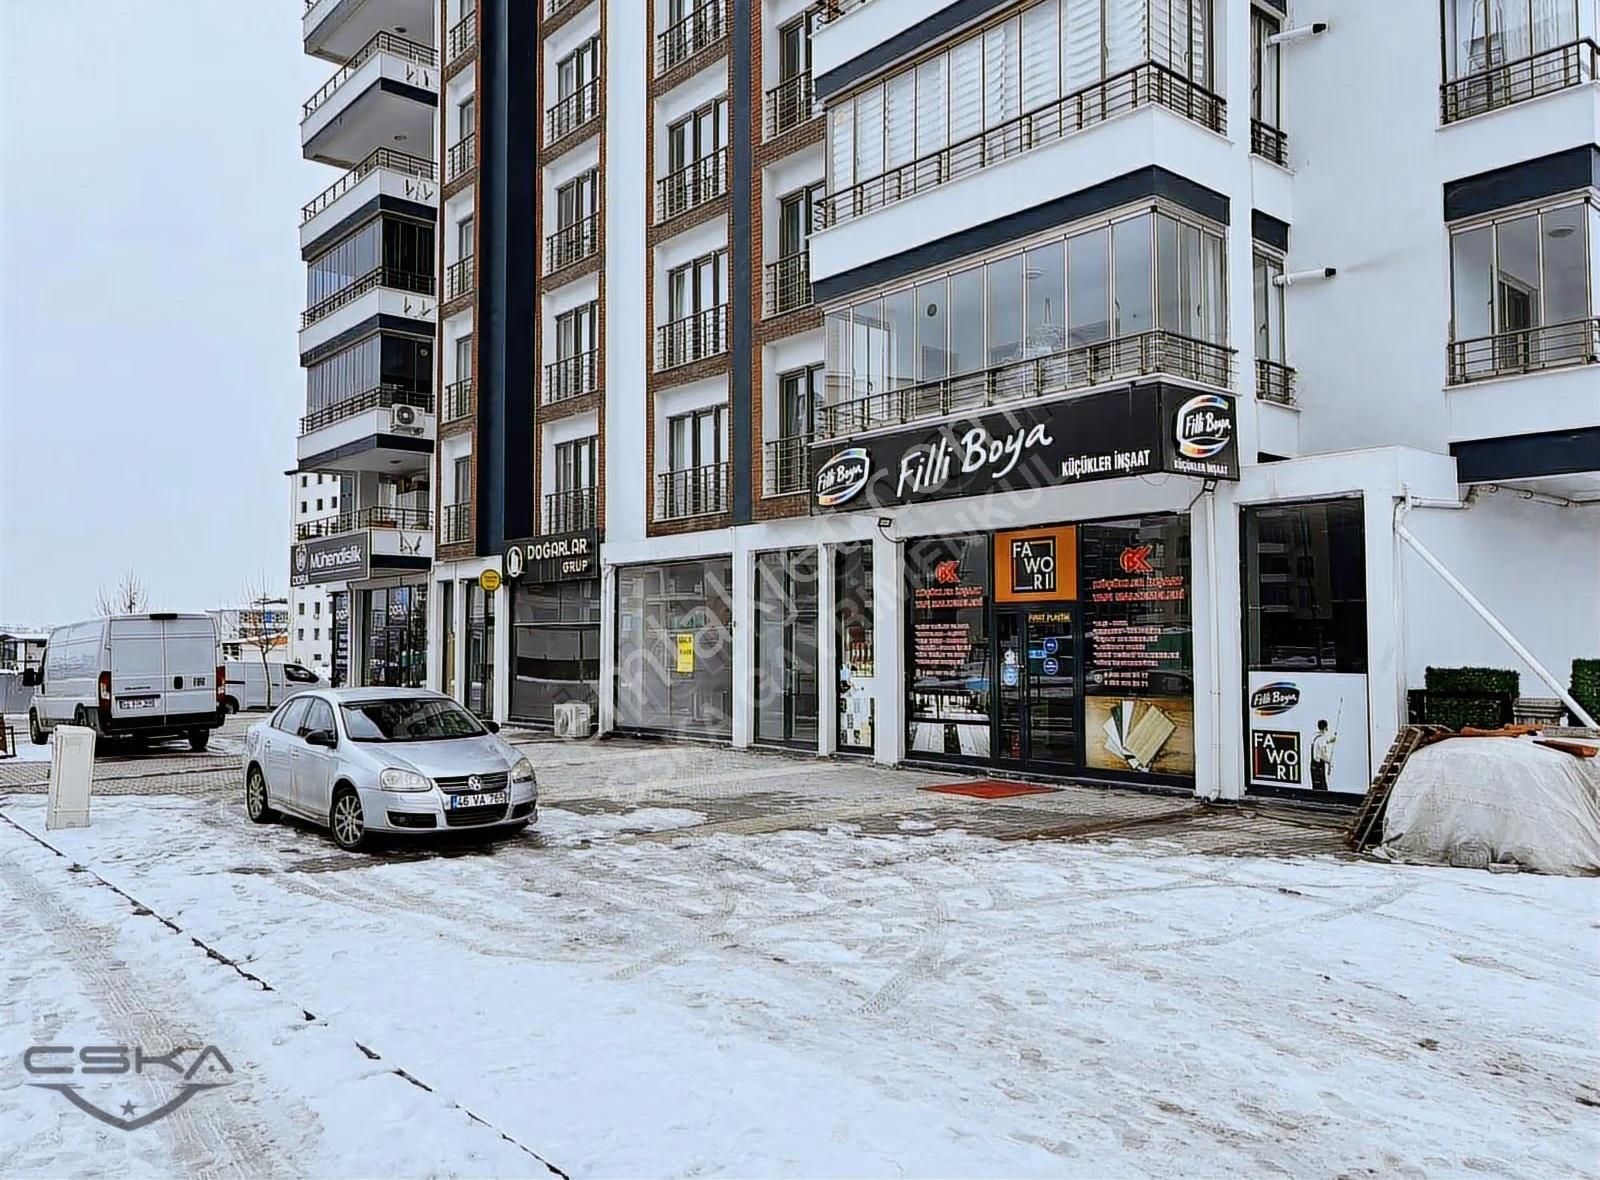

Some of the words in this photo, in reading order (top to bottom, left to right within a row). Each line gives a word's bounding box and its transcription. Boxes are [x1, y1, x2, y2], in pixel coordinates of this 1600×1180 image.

[1185, 412, 1204, 437] Filli
[1205, 412, 1231, 437] Boya
[896, 436, 953, 497] Filli
[961, 423, 1053, 478] Boya
[1061, 458, 1111, 480] KÜÇÜKLER
[1114, 449, 1150, 472] İNŞAAT
[817, 468, 835, 493] Filli
[837, 465, 863, 484] Boya
[527, 538, 587, 560] DOĞARLAR
[562, 559, 588, 573] GRUP
[1254, 690, 1272, 707] Filli
[1273, 691, 1298, 706] Boya
